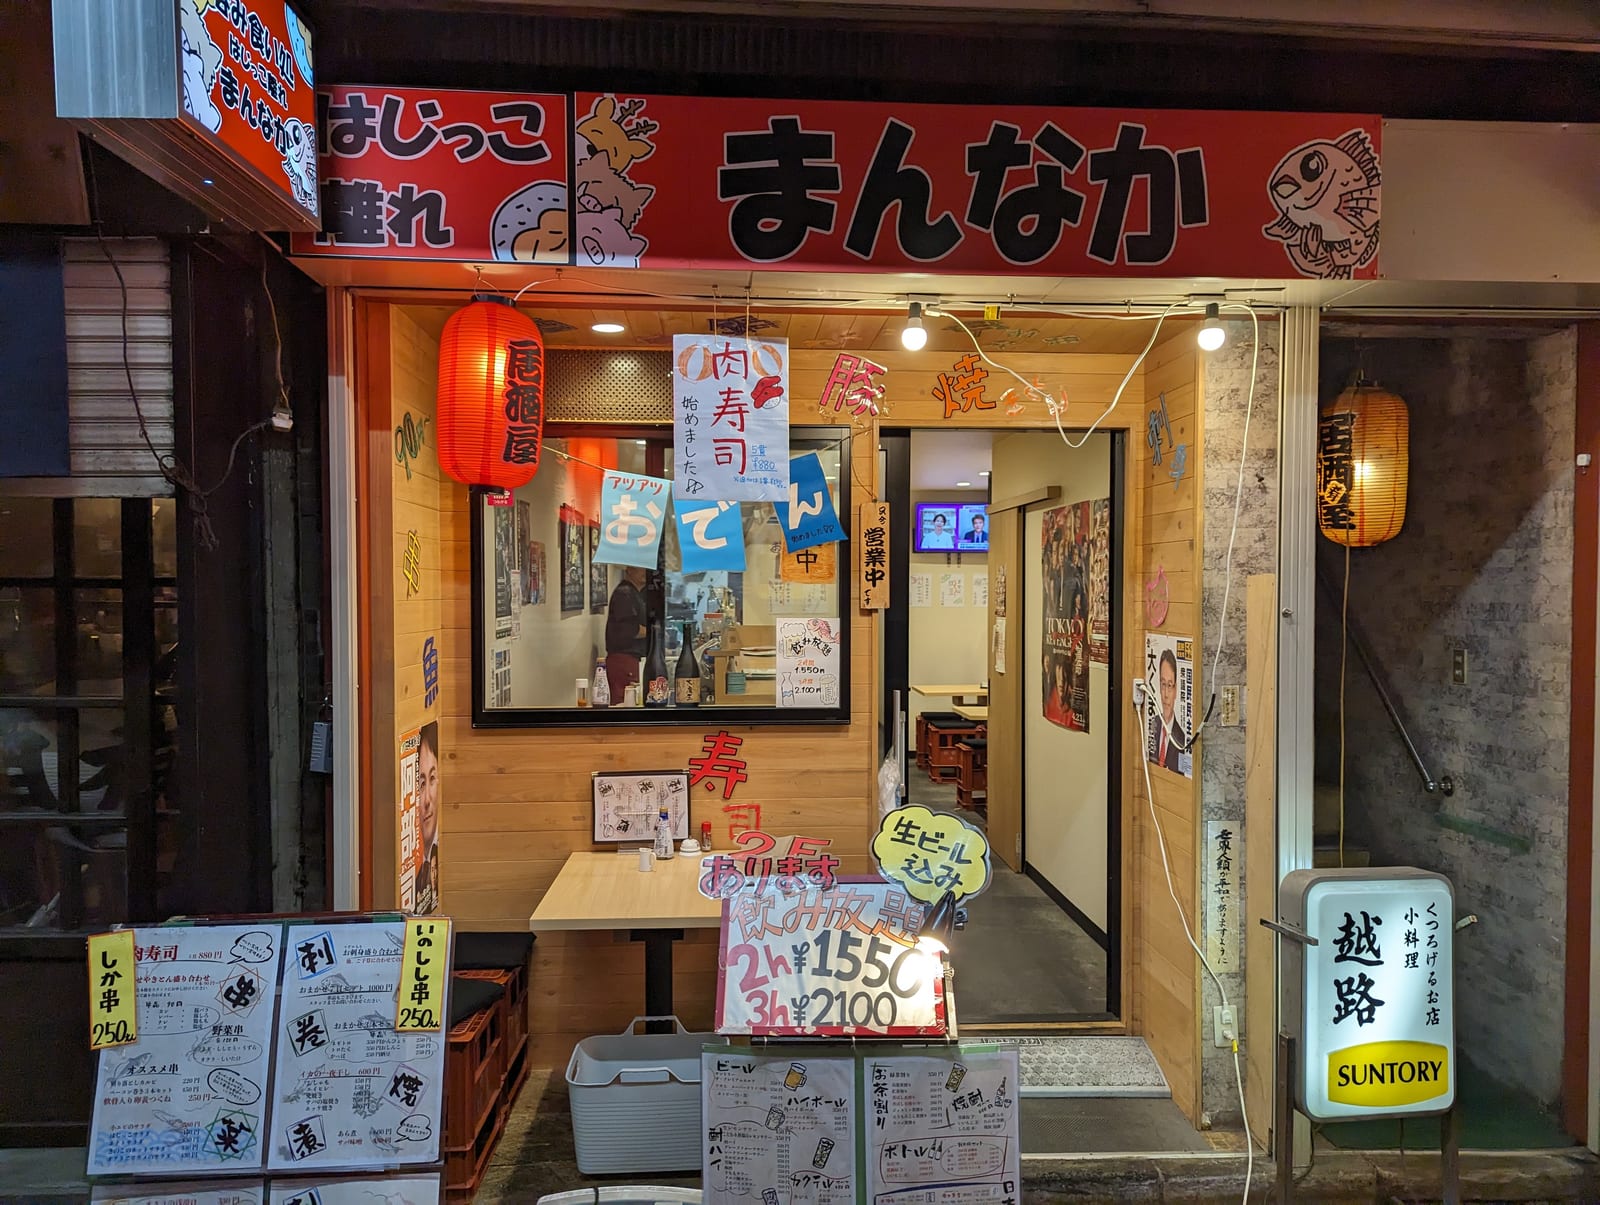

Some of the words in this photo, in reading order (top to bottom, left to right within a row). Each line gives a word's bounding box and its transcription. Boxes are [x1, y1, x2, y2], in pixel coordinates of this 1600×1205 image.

[220, 67, 293, 154] まんなか
[316, 94, 549, 160] はじっこ
[720, 116, 1207, 262] まんなか
[711, 342, 750, 475] 肉寿司
[607, 475, 664, 496] アツアツ
[863, 526, 886, 588] 営業中
[1046, 617, 1084, 636] TOKYO
[890, 815, 973, 865] 生ビール
[700, 854, 840, 899] あります
[900, 853, 963, 892] 込み
[1215, 828, 1233, 965] 世界人類が平和でありますように
[298, 937, 334, 974] 刺
[1404, 907, 1420, 969] 小料理
[100, 951, 123, 1013] しか串
[410, 924, 434, 1005] いのしし串
[728, 942, 793, 994] 2h
[1332, 911, 1385, 1027] 越路
[1425, 901, 1441, 1027] くつろげるお店
[223, 975, 256, 1009] 串
[744, 989, 791, 1028] 3h
[791, 986, 898, 1028] ¥2100
[212, 1024, 244, 1036] 野菜串
[295, 1015, 325, 1051] 巻
[126, 1064, 179, 1075] オススメ串
[717, 1060, 756, 1073] ビール
[1337, 1060, 1443, 1087] SUNTORY
[787, 1096, 847, 1107] ハイボール
[872, 1068, 889, 1130] お茶割り
[884, 1144, 928, 1159] ボトル
[790, 1174, 834, 1189] カクテル
